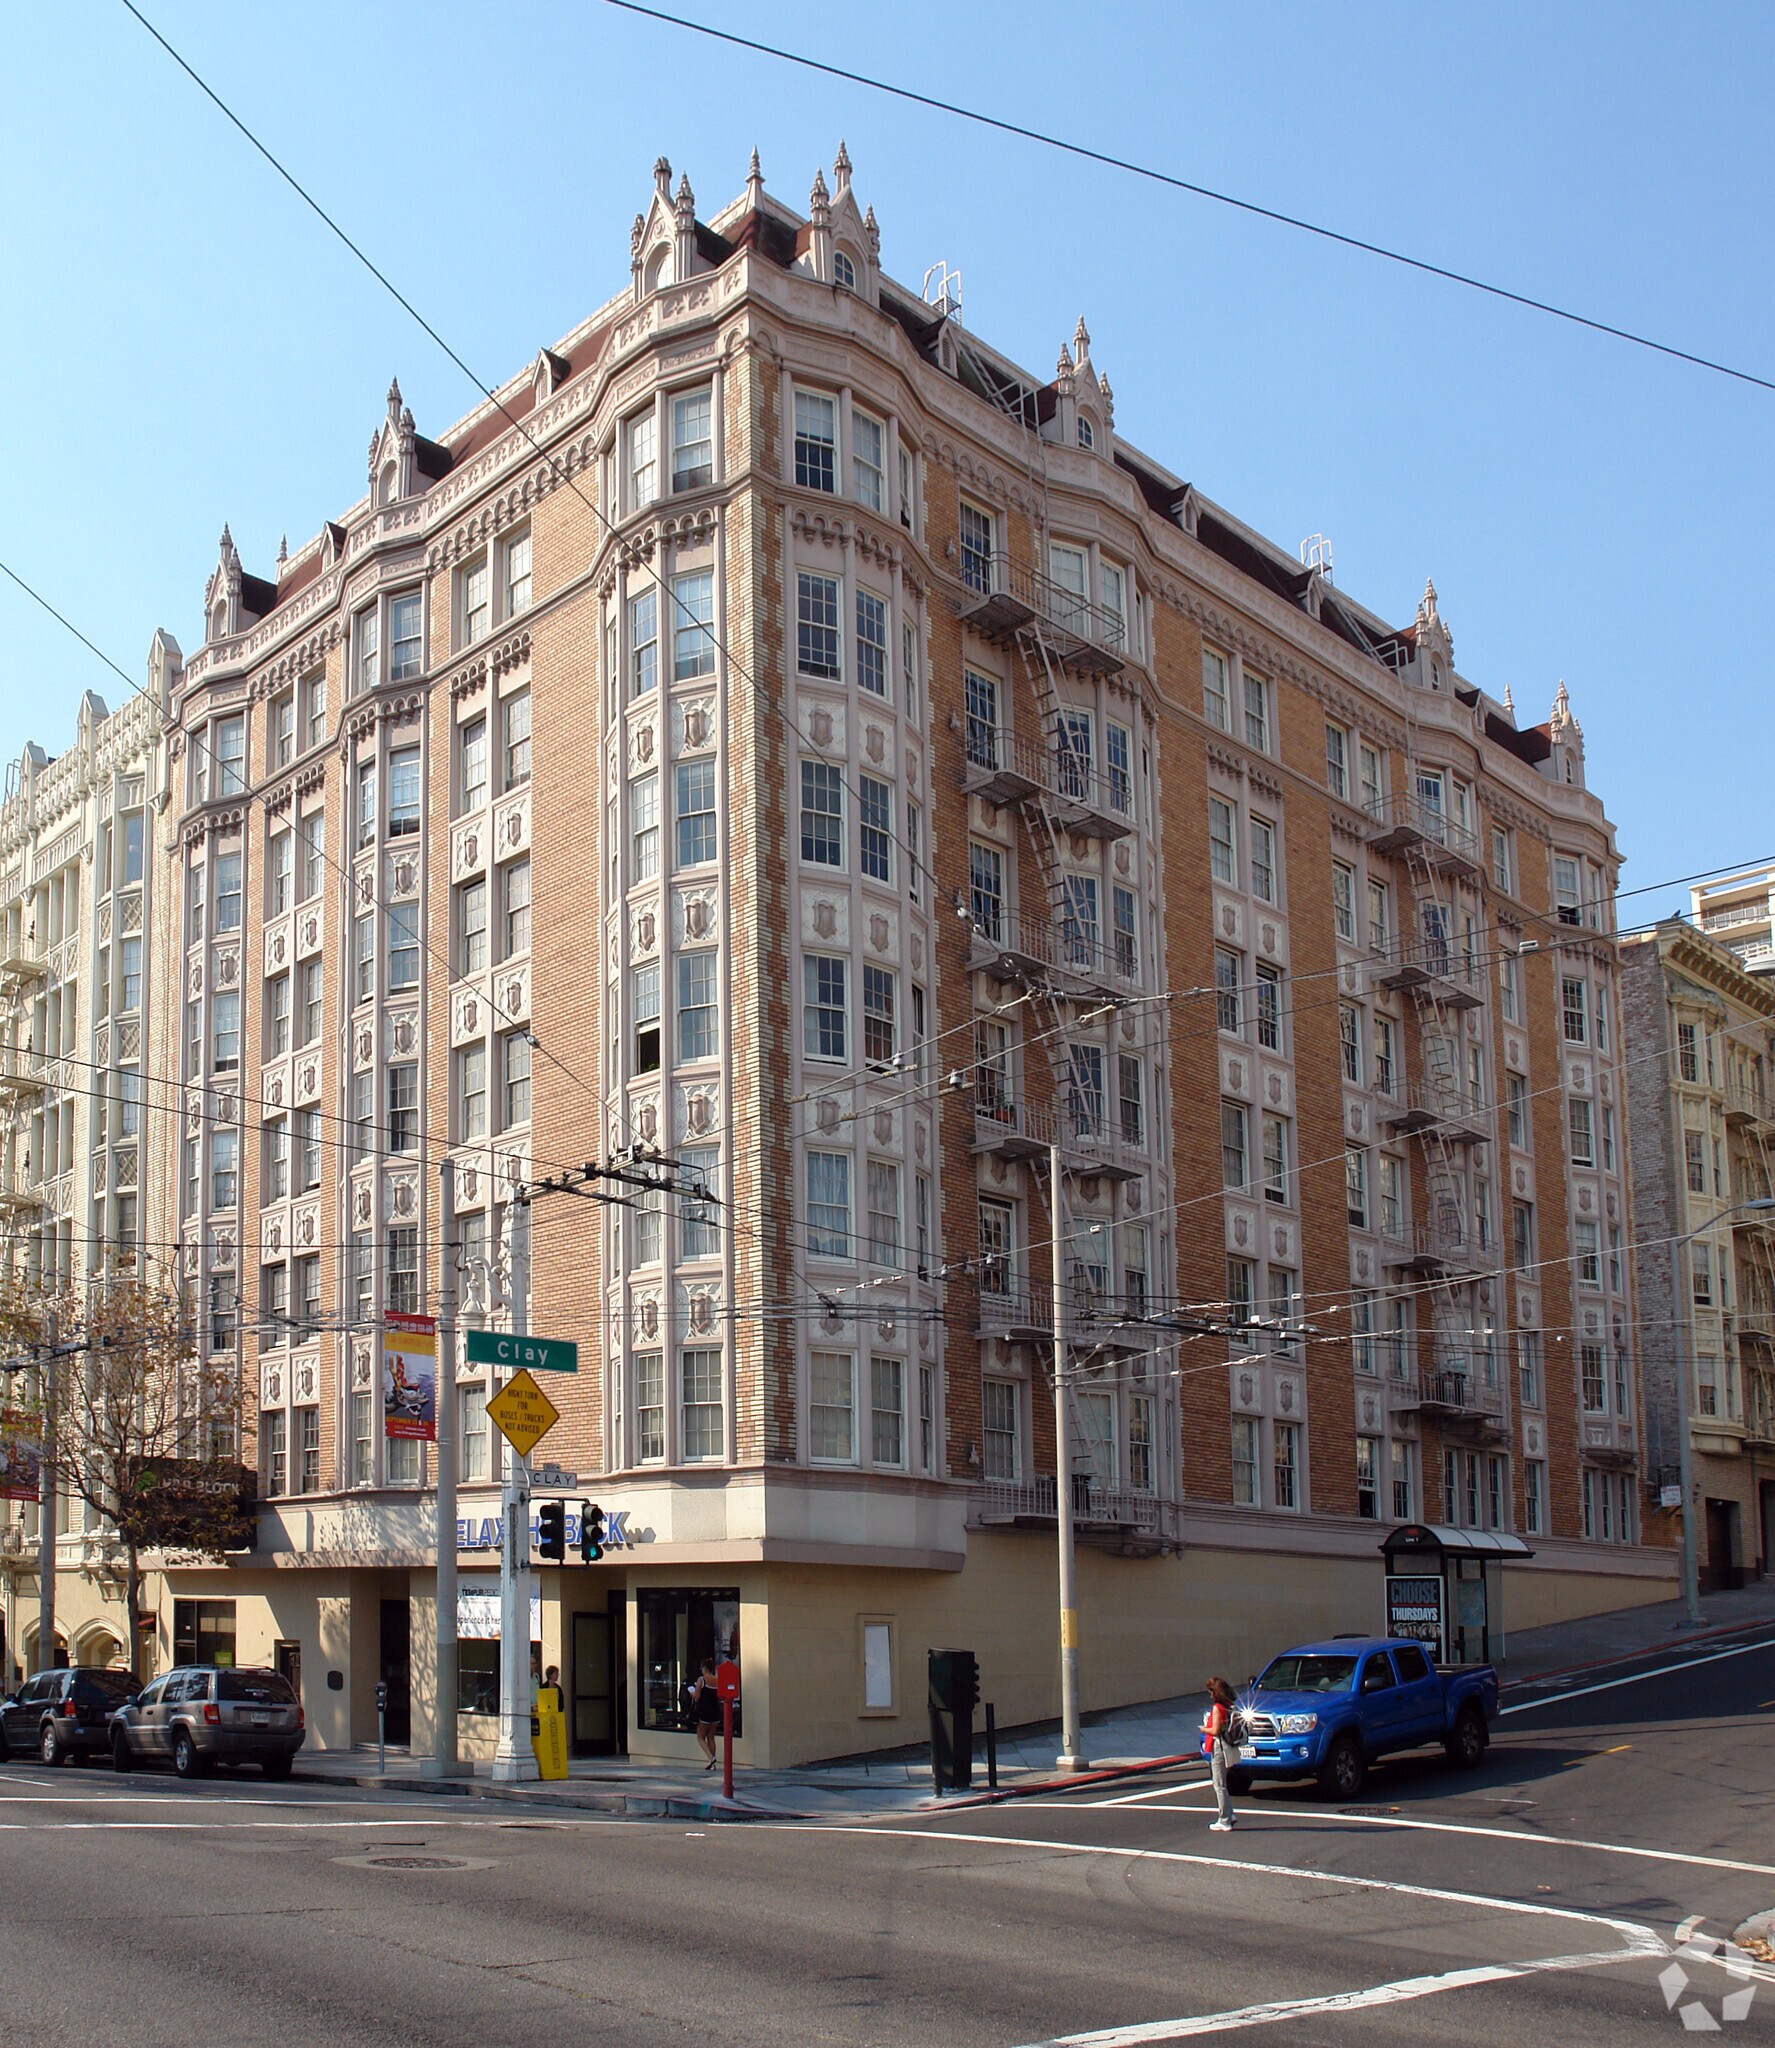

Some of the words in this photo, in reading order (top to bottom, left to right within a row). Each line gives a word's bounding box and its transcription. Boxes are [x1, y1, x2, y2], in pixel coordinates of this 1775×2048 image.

[497, 1341, 548, 1366] Clay
[507, 1388, 523, 1398] RIGHT
[524, 1390, 538, 1400] TURN
[517, 1401, 528, 1410] FOR
[500, 1410, 517, 1420] BUSES
[524, 1413, 545, 1423] TRUCKS
[505, 1422, 515, 1431] NOT
[517, 1424, 540, 1434] ADVISED
[533, 1472, 572, 1485] CLAY
[456, 1517, 505, 1547] ELAX
[1391, 1581, 1438, 1604] CHOOSE
[1391, 1607, 1438, 1621] THURSDAYS
